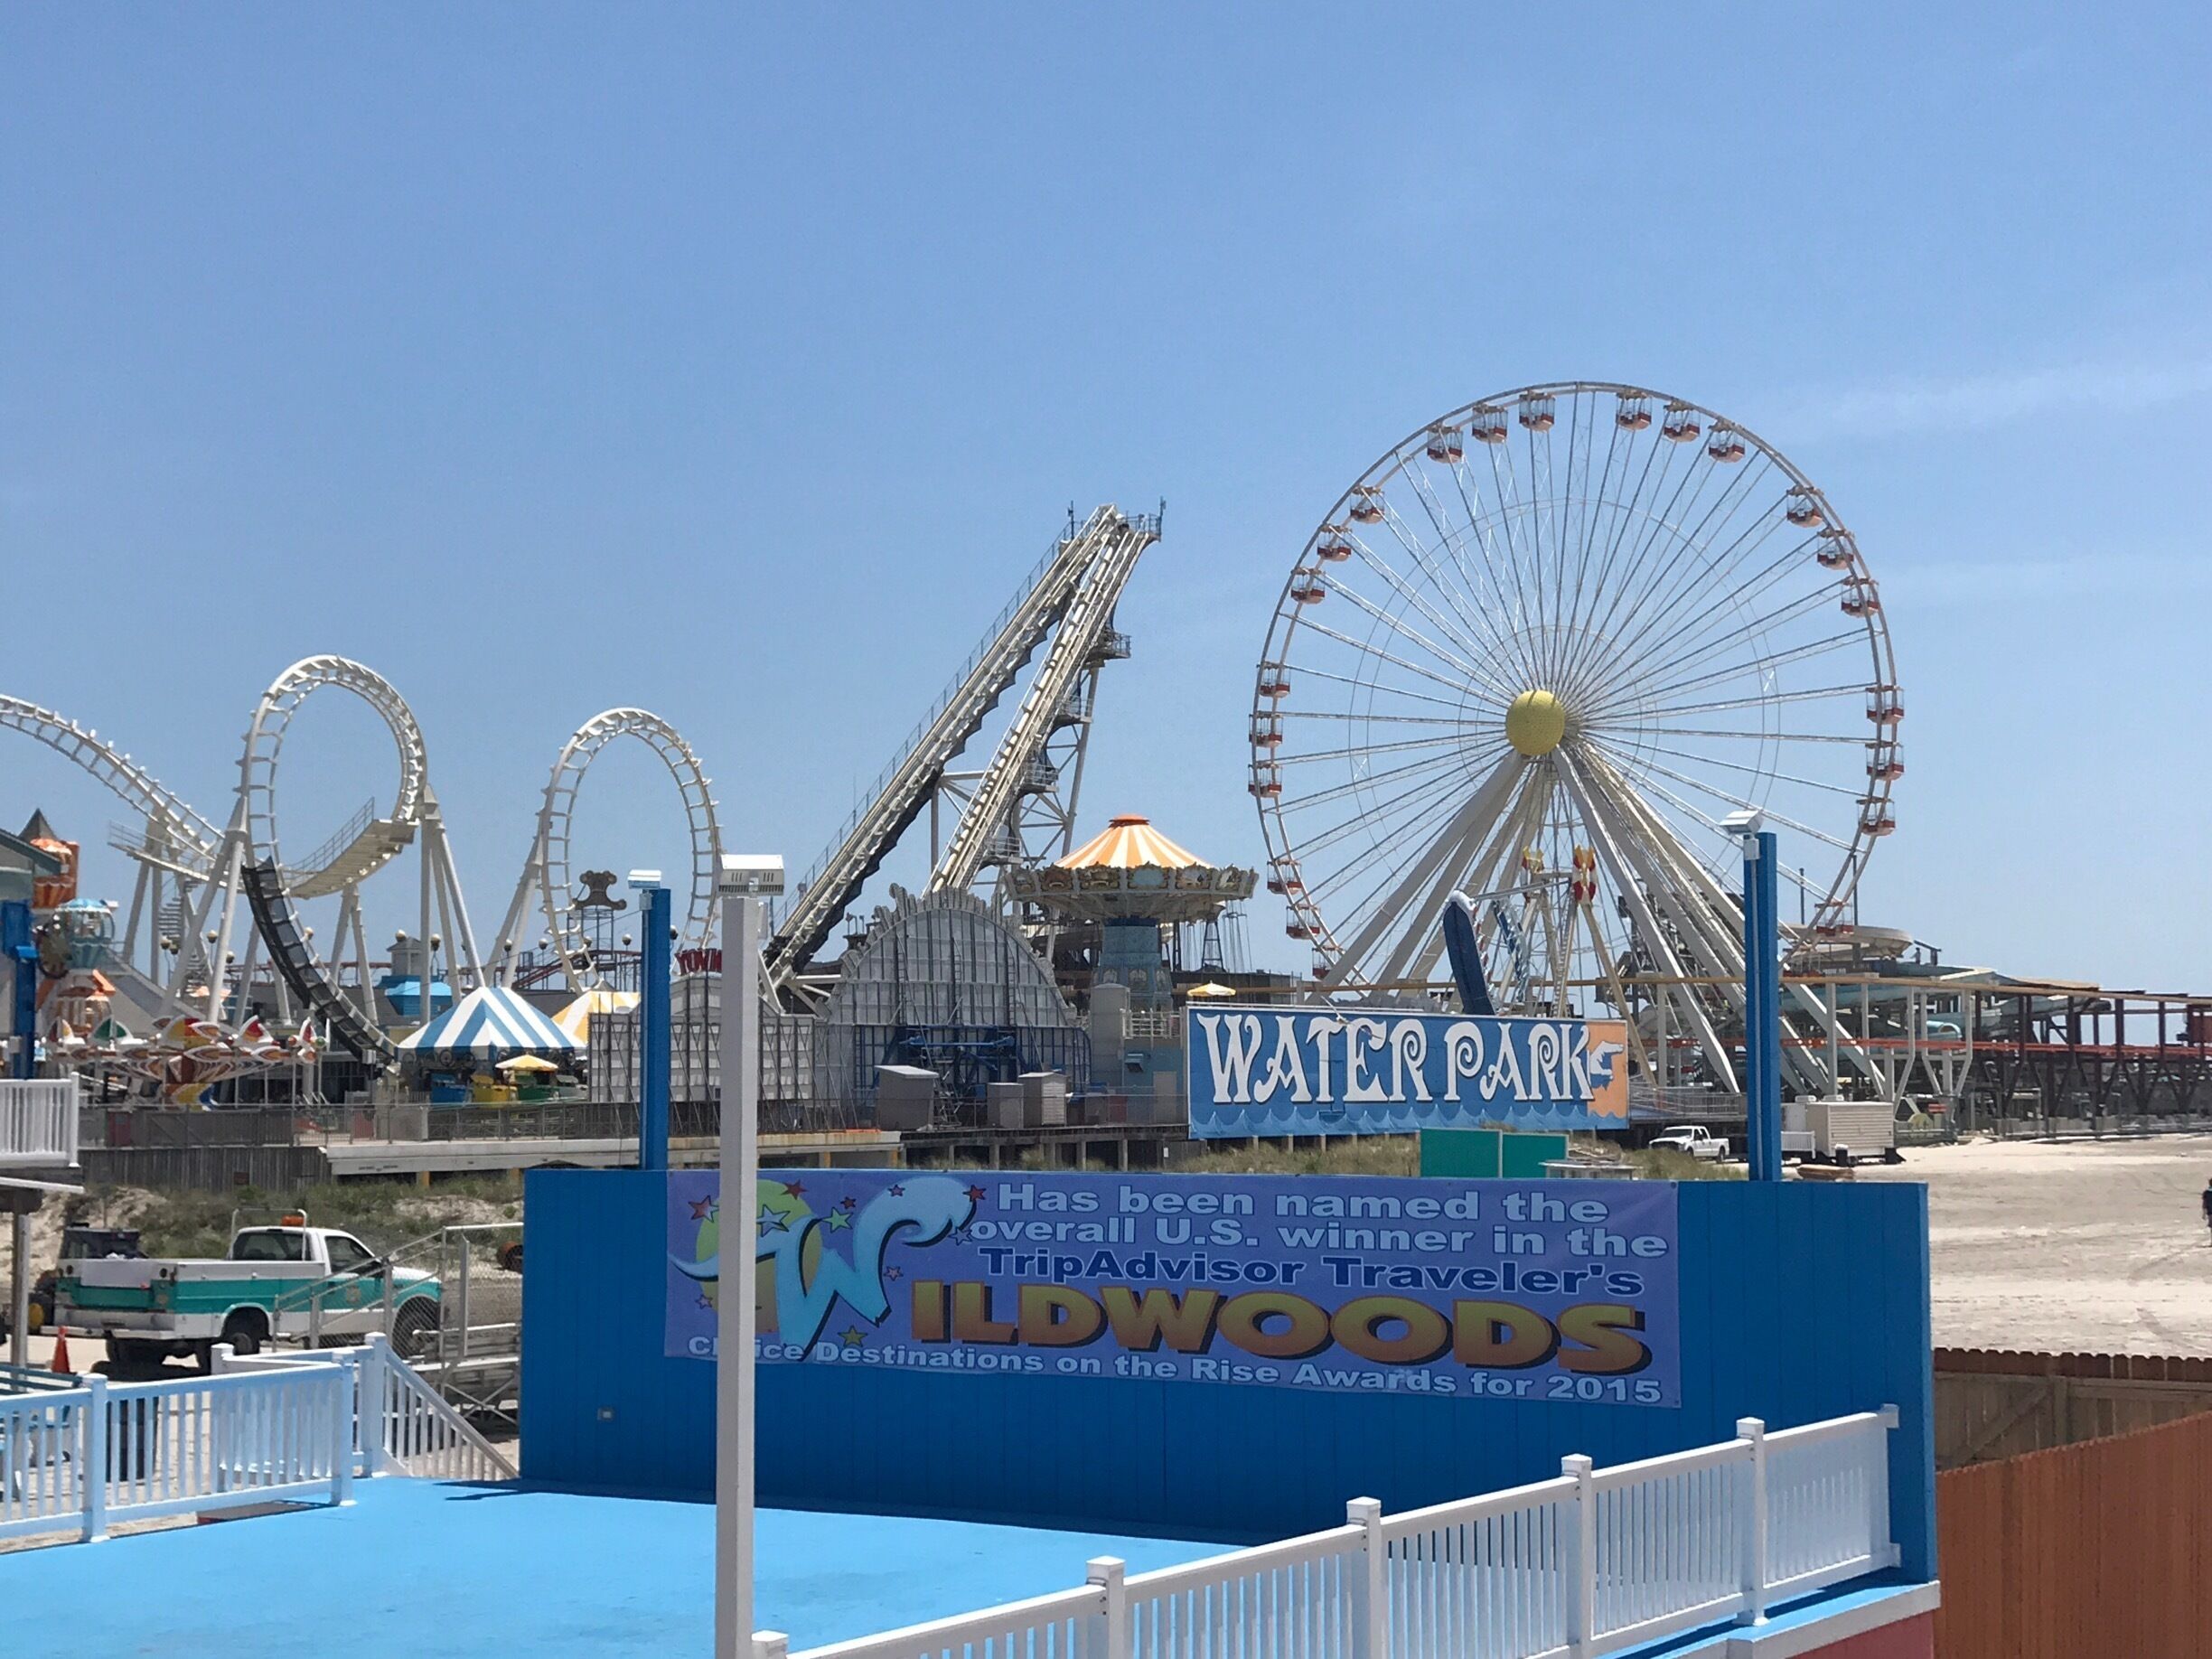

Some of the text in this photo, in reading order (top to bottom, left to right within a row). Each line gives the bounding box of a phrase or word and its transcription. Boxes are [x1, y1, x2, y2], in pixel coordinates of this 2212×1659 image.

[1197, 1013, 1595, 1103] WATER PARK
[998, 1183, 1610, 1223] Has been named the
[968, 1217, 1669, 1259] overall U.S. winner in the
[978, 1246, 1645, 1297] TripAdvisor Traveler's
[688, 1336, 1663, 1403] Cice Destinations on the Rise Awards for 2015
